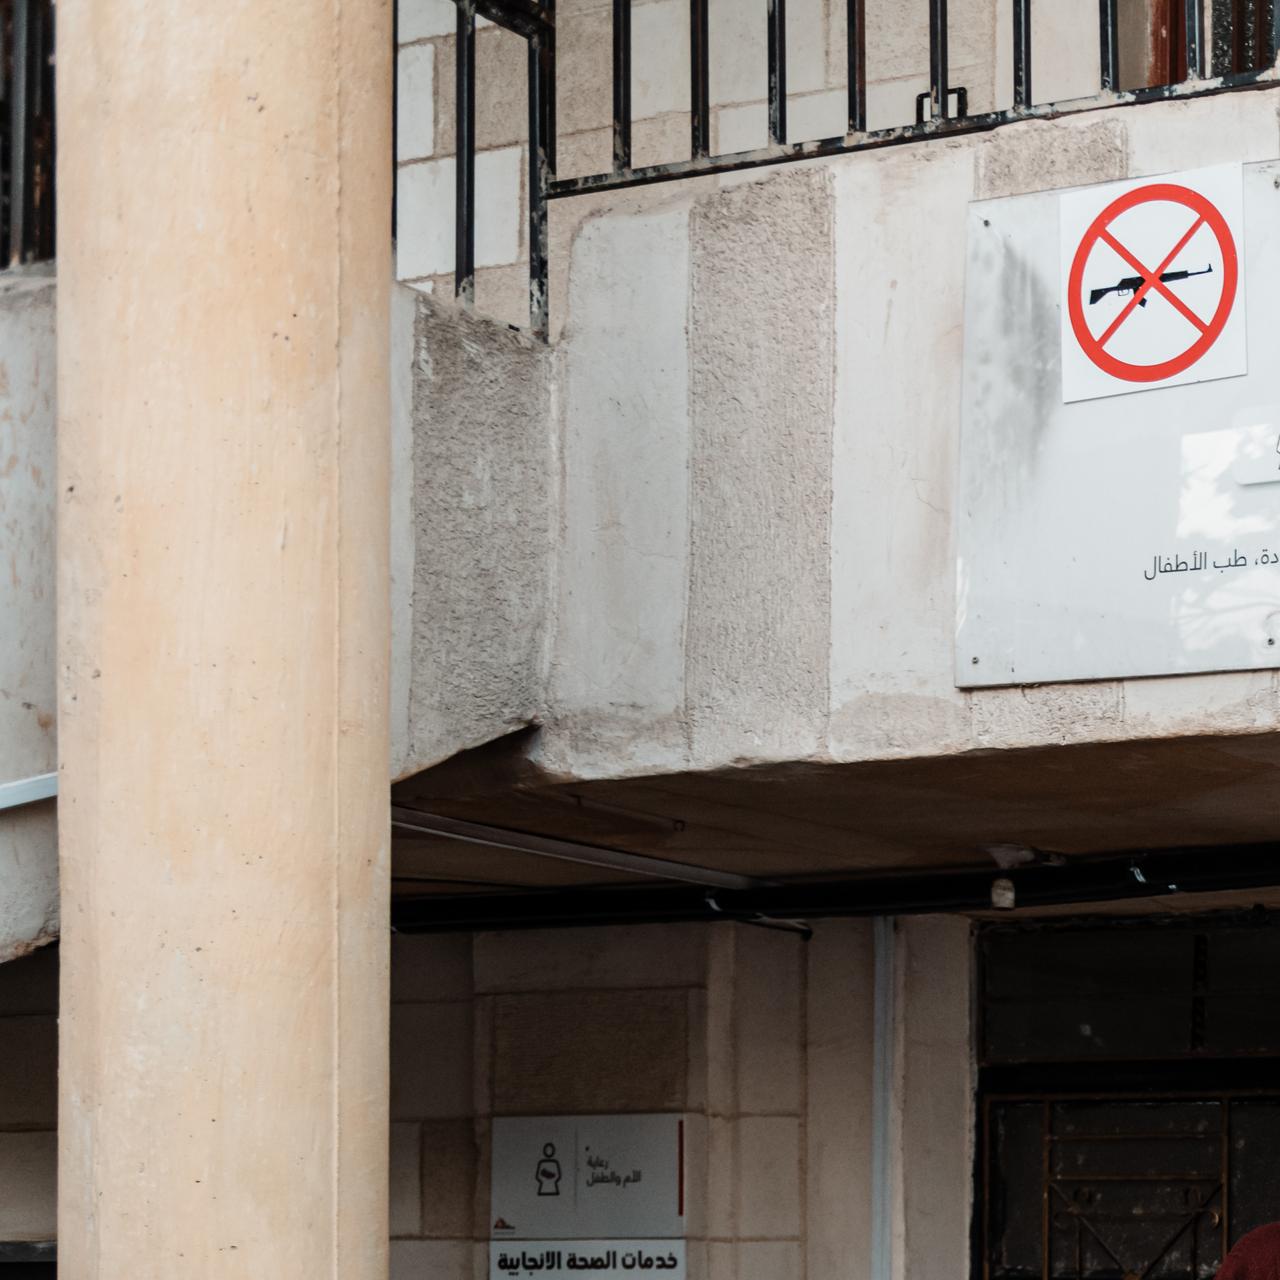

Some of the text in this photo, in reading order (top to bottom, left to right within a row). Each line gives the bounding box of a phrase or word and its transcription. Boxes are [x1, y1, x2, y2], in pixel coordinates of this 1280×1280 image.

[497, 1249, 679, 1277] خدمات الصحة الانجابية
